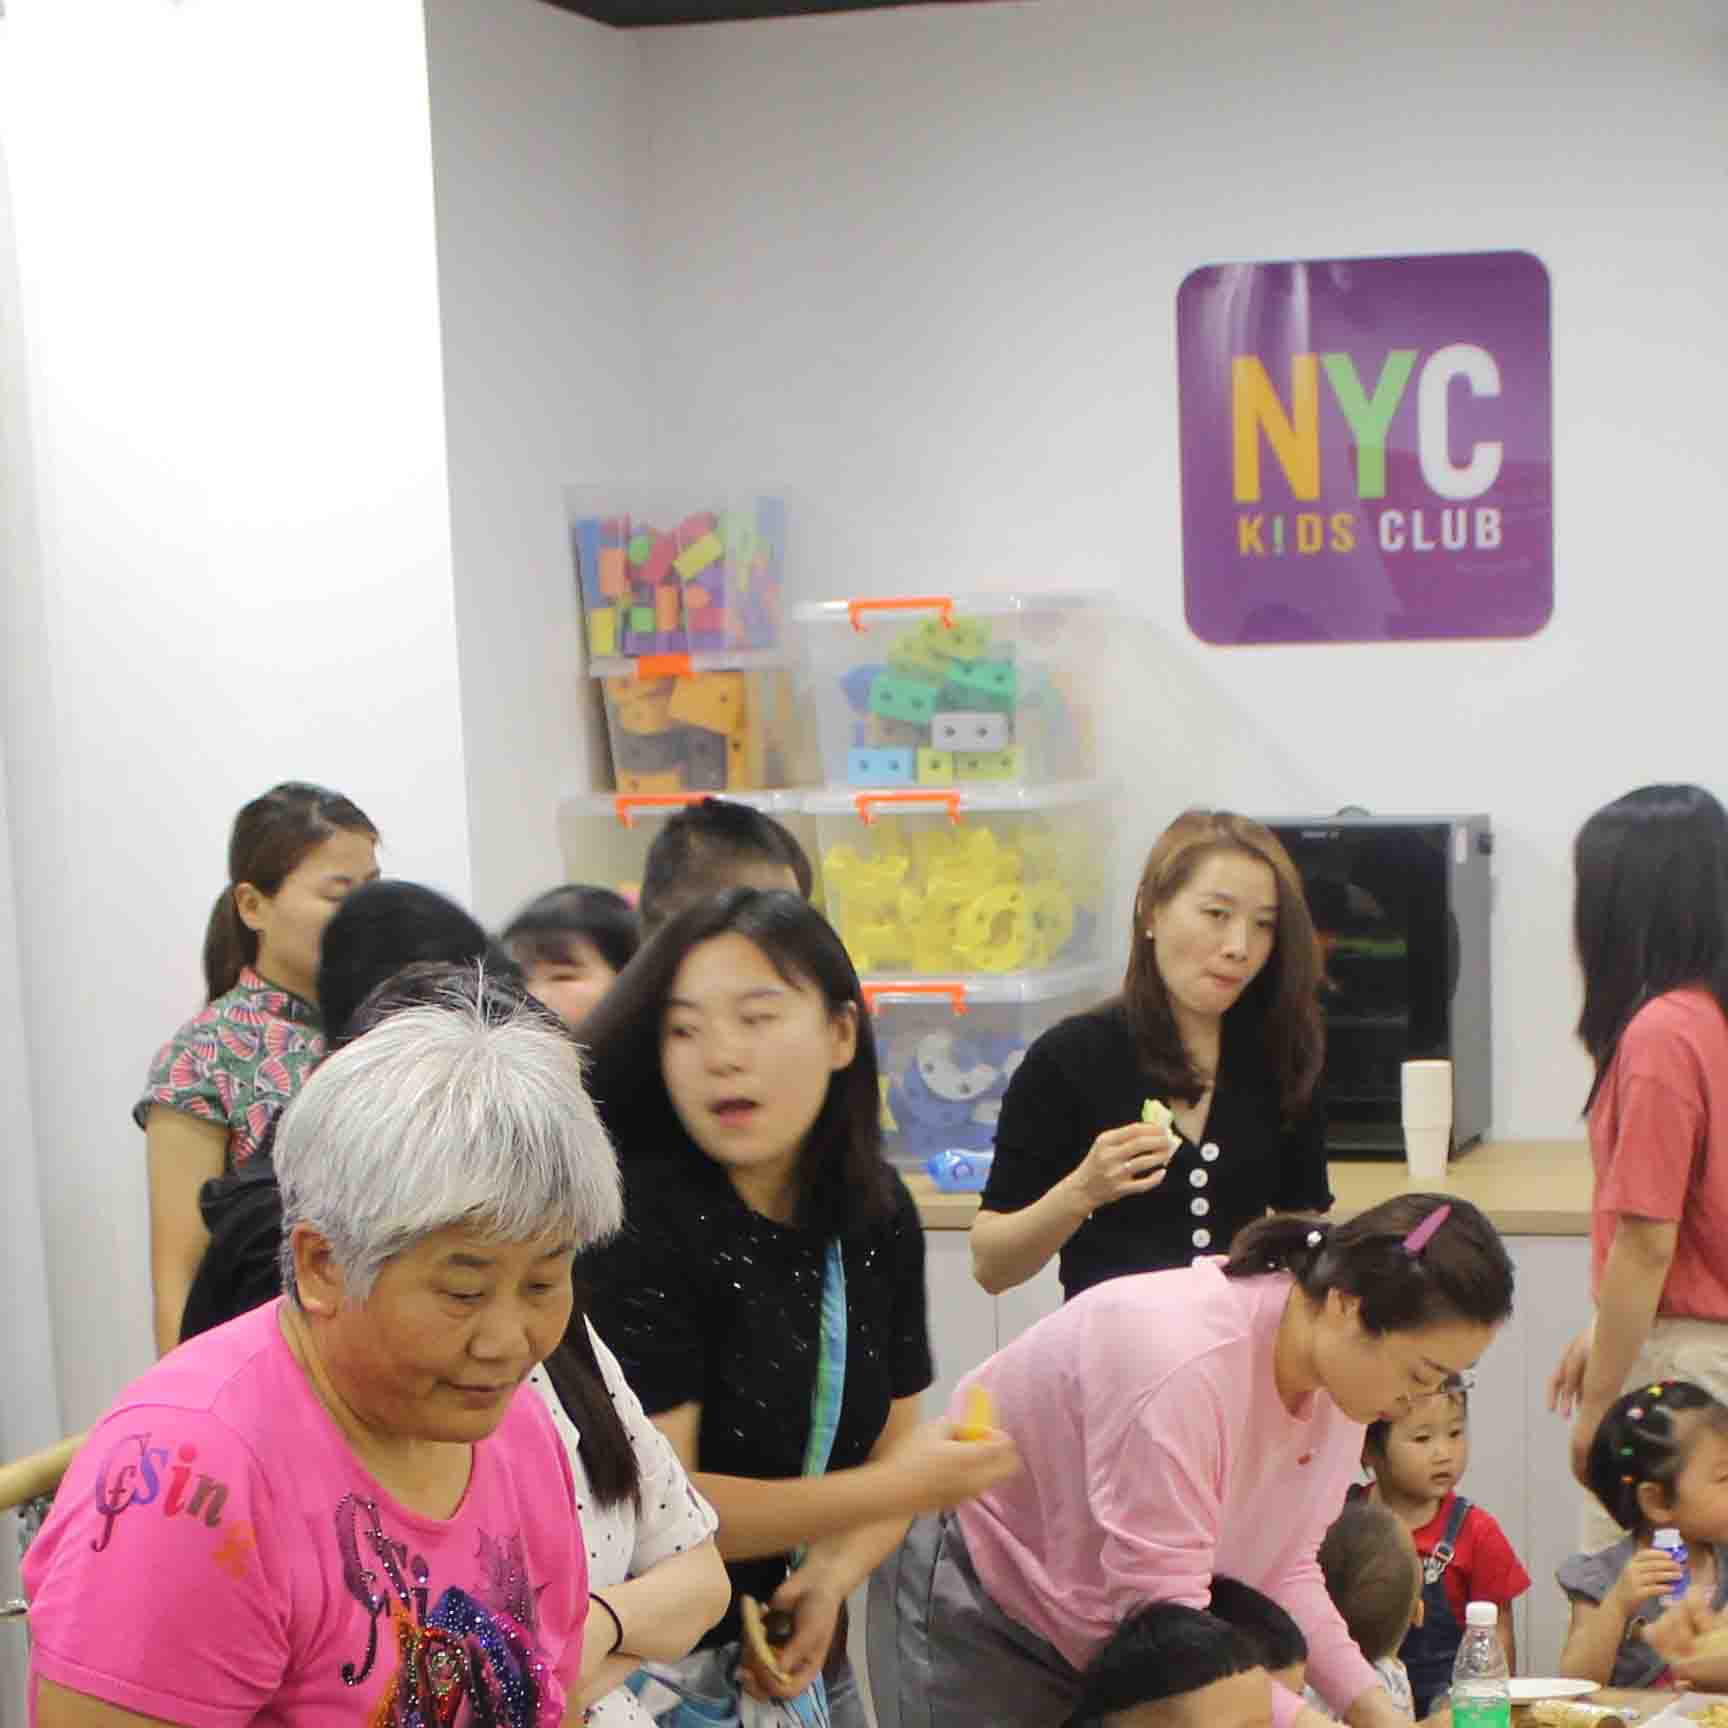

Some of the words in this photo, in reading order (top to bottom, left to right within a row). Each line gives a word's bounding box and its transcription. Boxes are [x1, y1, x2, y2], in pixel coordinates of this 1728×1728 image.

[1231, 343, 1503, 502] NYC
[1237, 512, 1357, 557] KIDS
[1378, 507, 1503, 553] CLUB
